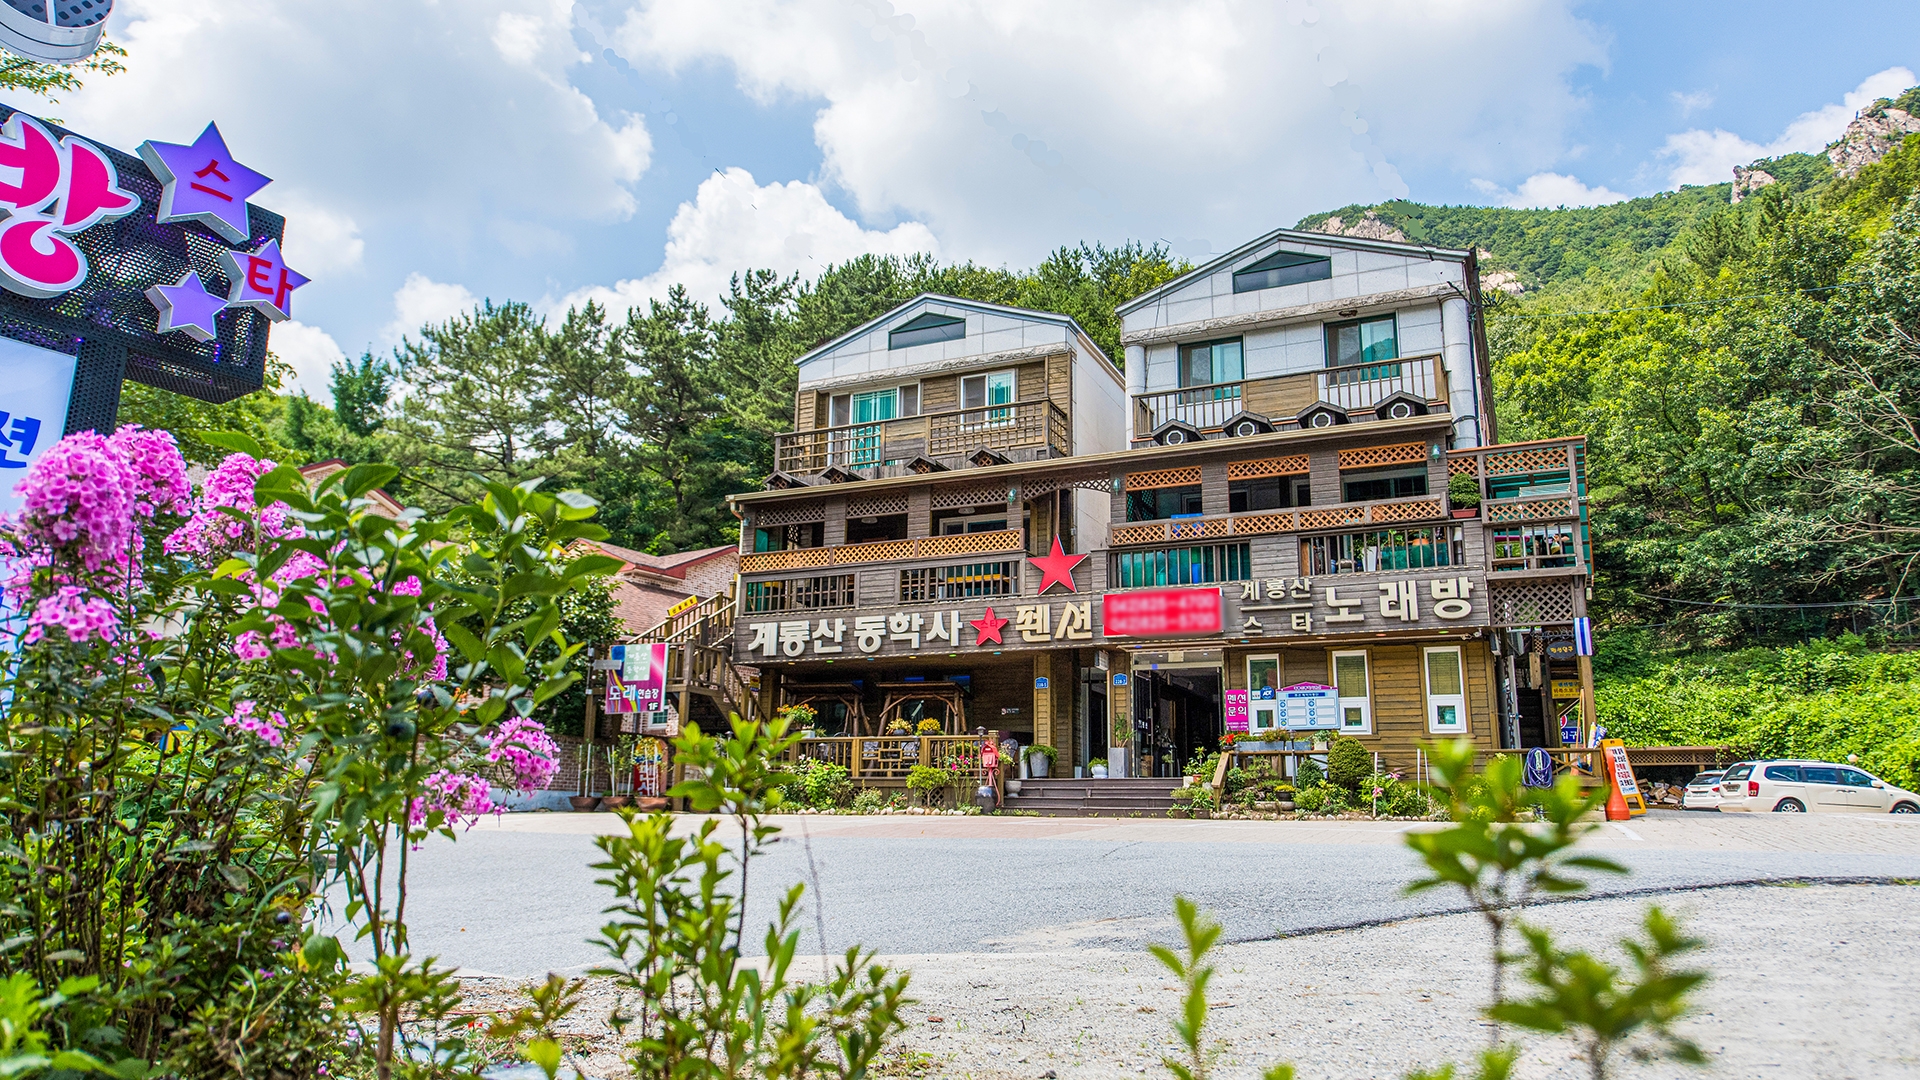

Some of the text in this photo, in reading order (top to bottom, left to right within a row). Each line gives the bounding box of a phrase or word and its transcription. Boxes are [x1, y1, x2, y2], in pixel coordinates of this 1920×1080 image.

[1240, 577, 1313, 602] 계룡산
[1324, 576, 1474, 622] 노래방
[748, 618, 847, 657] 계룡산
[853, 610, 963, 654] 동학사
[980, 619, 998, 629] 스타
[1015, 601, 1093, 643] 펜션
[648, 702, 659, 711] 1F
[1227, 693, 1247, 704] 펜션
[1227, 706, 1247, 717] 문의
